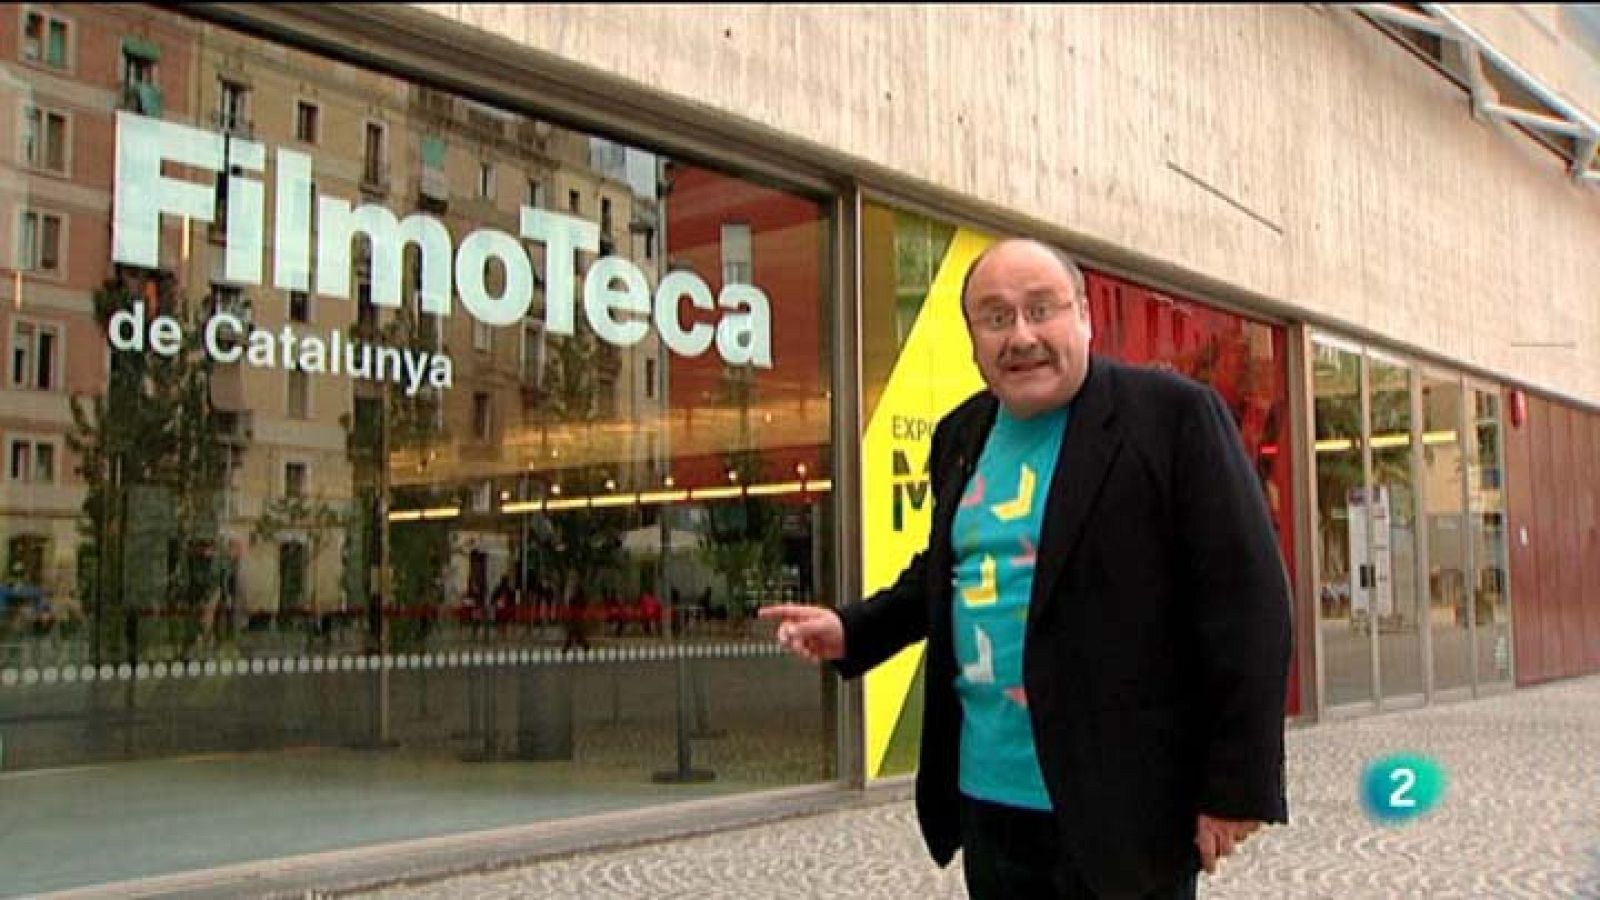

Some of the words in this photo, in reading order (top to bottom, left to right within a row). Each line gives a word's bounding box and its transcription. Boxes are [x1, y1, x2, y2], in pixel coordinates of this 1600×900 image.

[112, 111, 772, 368] FilmoTeca
[109, 301, 182, 355] de
[205, 313, 453, 395] Catalunya
[892, 415, 933, 441] EXP
